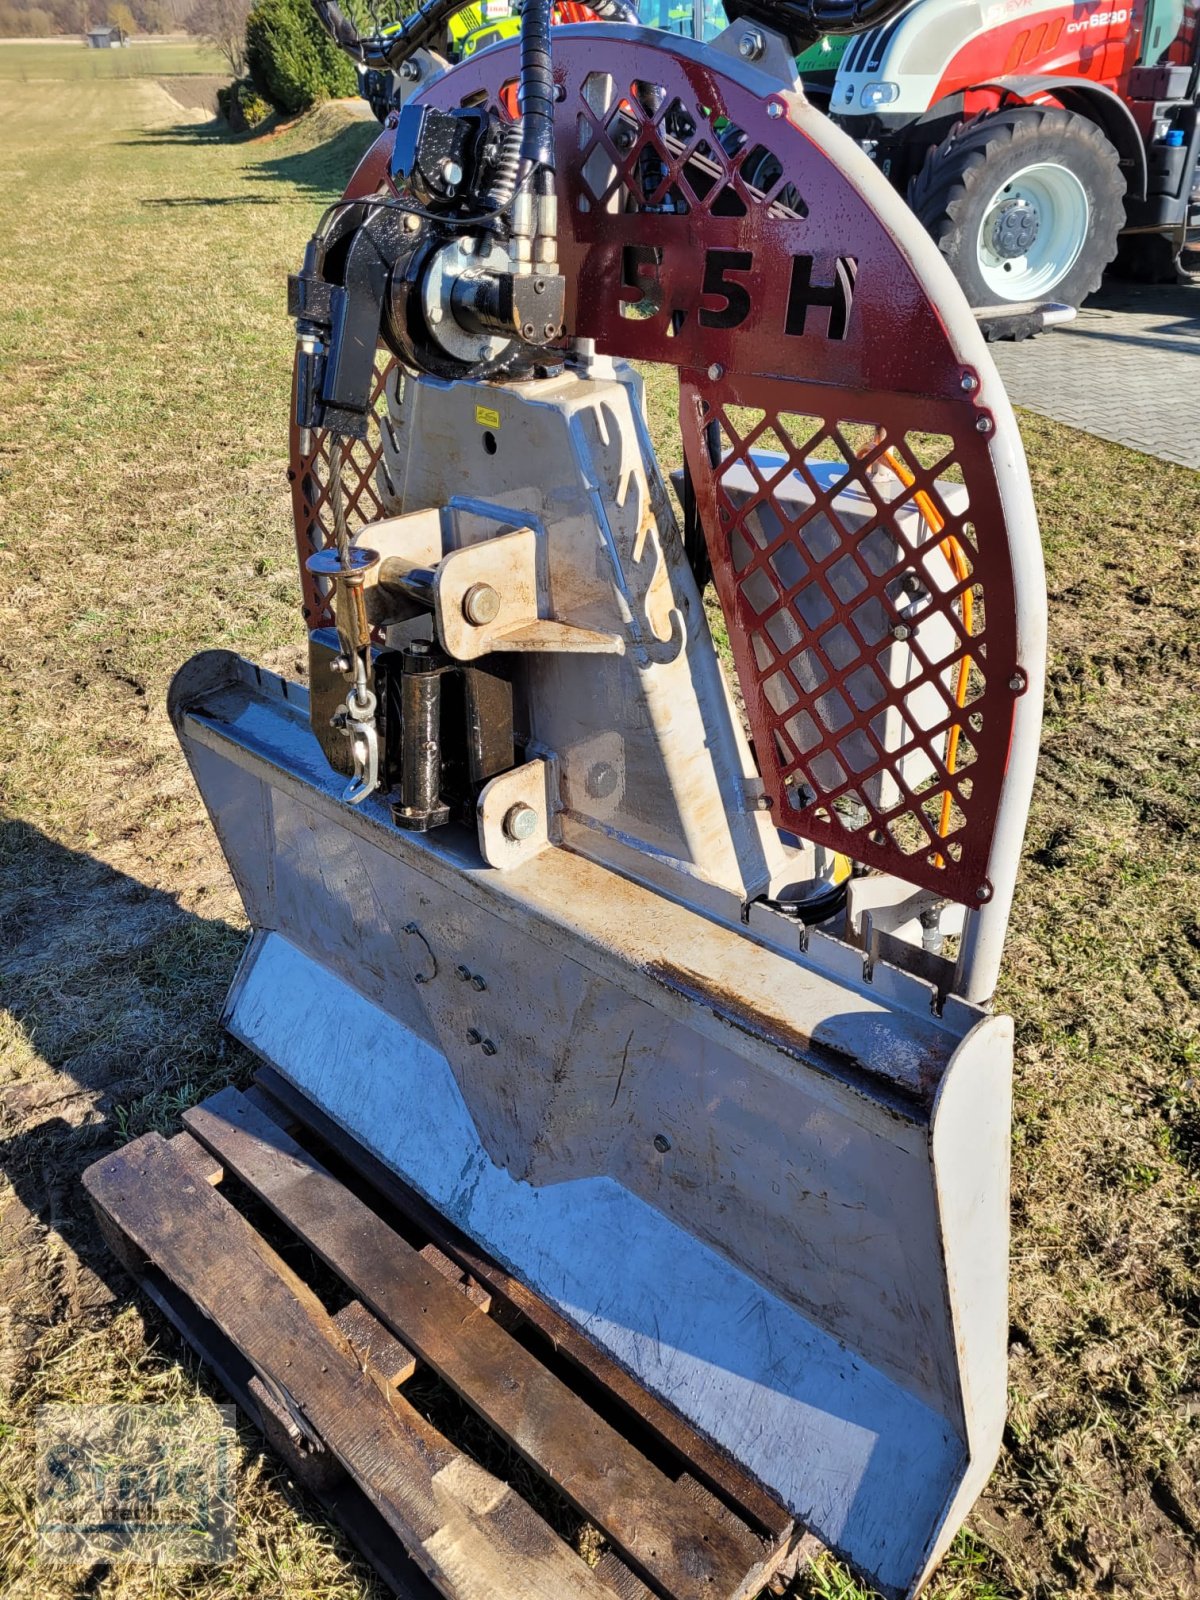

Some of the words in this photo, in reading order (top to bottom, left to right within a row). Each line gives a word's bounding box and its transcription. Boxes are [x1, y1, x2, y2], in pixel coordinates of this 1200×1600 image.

[1089, 9, 1127, 28] 6230
[619, 246, 753, 338] 5,5
[784, 254, 859, 341] H
